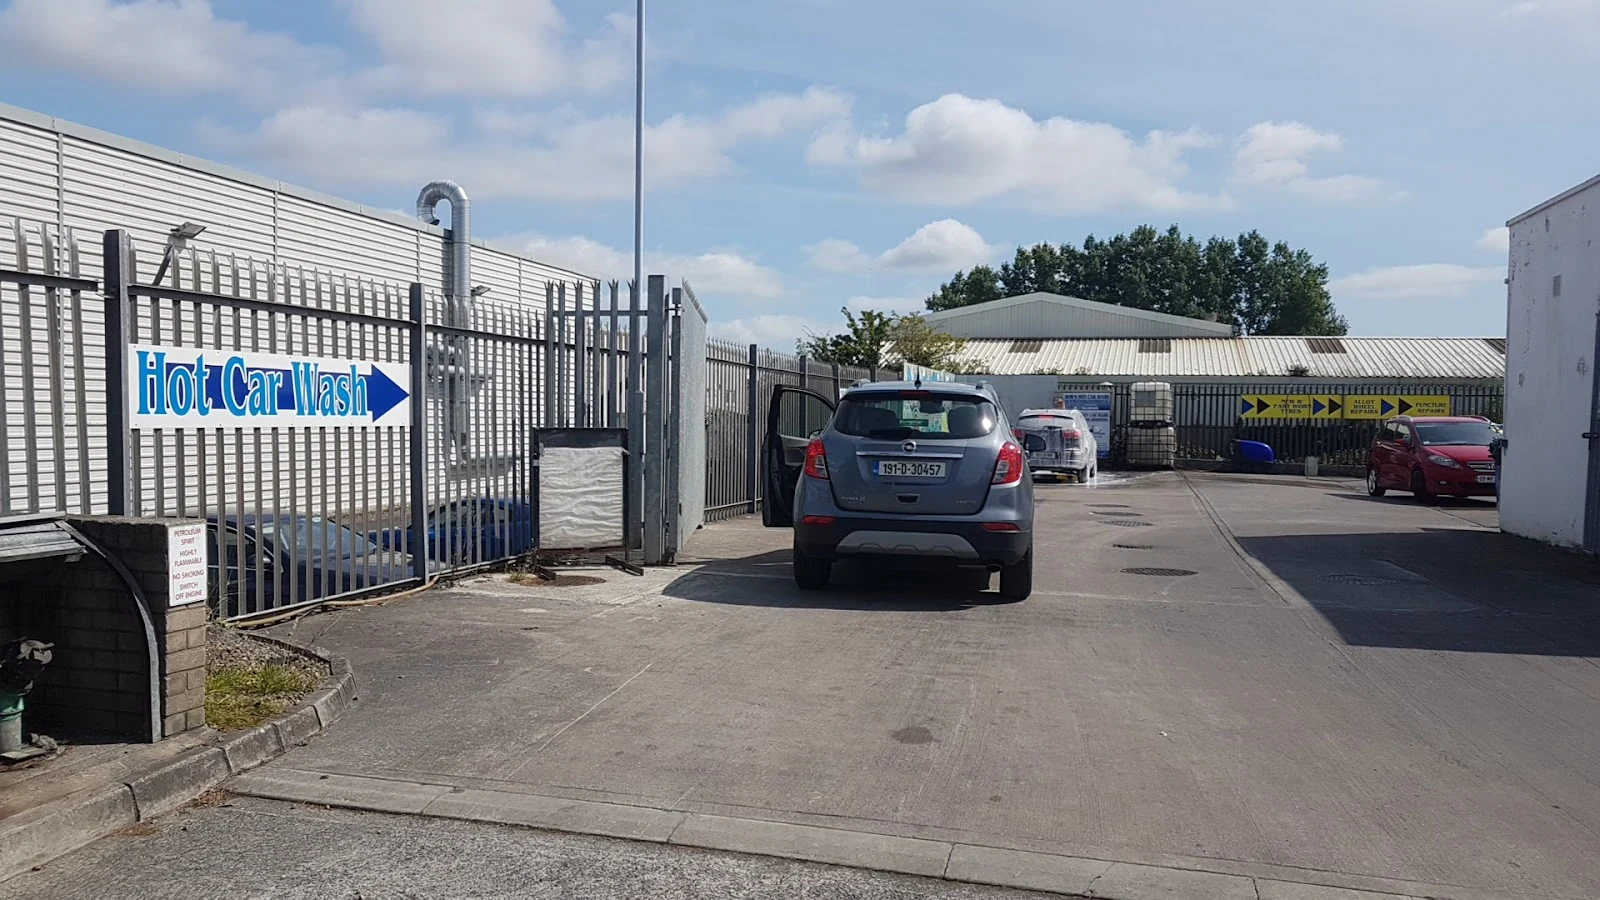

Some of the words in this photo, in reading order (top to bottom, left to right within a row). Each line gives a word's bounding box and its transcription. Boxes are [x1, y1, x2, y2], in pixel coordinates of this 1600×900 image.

[136, 350, 211, 416] Hot
[221, 355, 282, 417] Car
[291, 361, 368, 417] Wash
[883, 463, 941, 476] 191-D-30457
[174, 528, 201, 537] PETROLEUM
[180, 549, 197, 557] HIGHLY
[174, 557, 203, 567] FLAMMABLE
[182, 569, 204, 579] SMOKING
[180, 582, 198, 590] SWITCH
[175, 593, 184, 601] OFF
[185, 590, 203, 599] ENGINE
